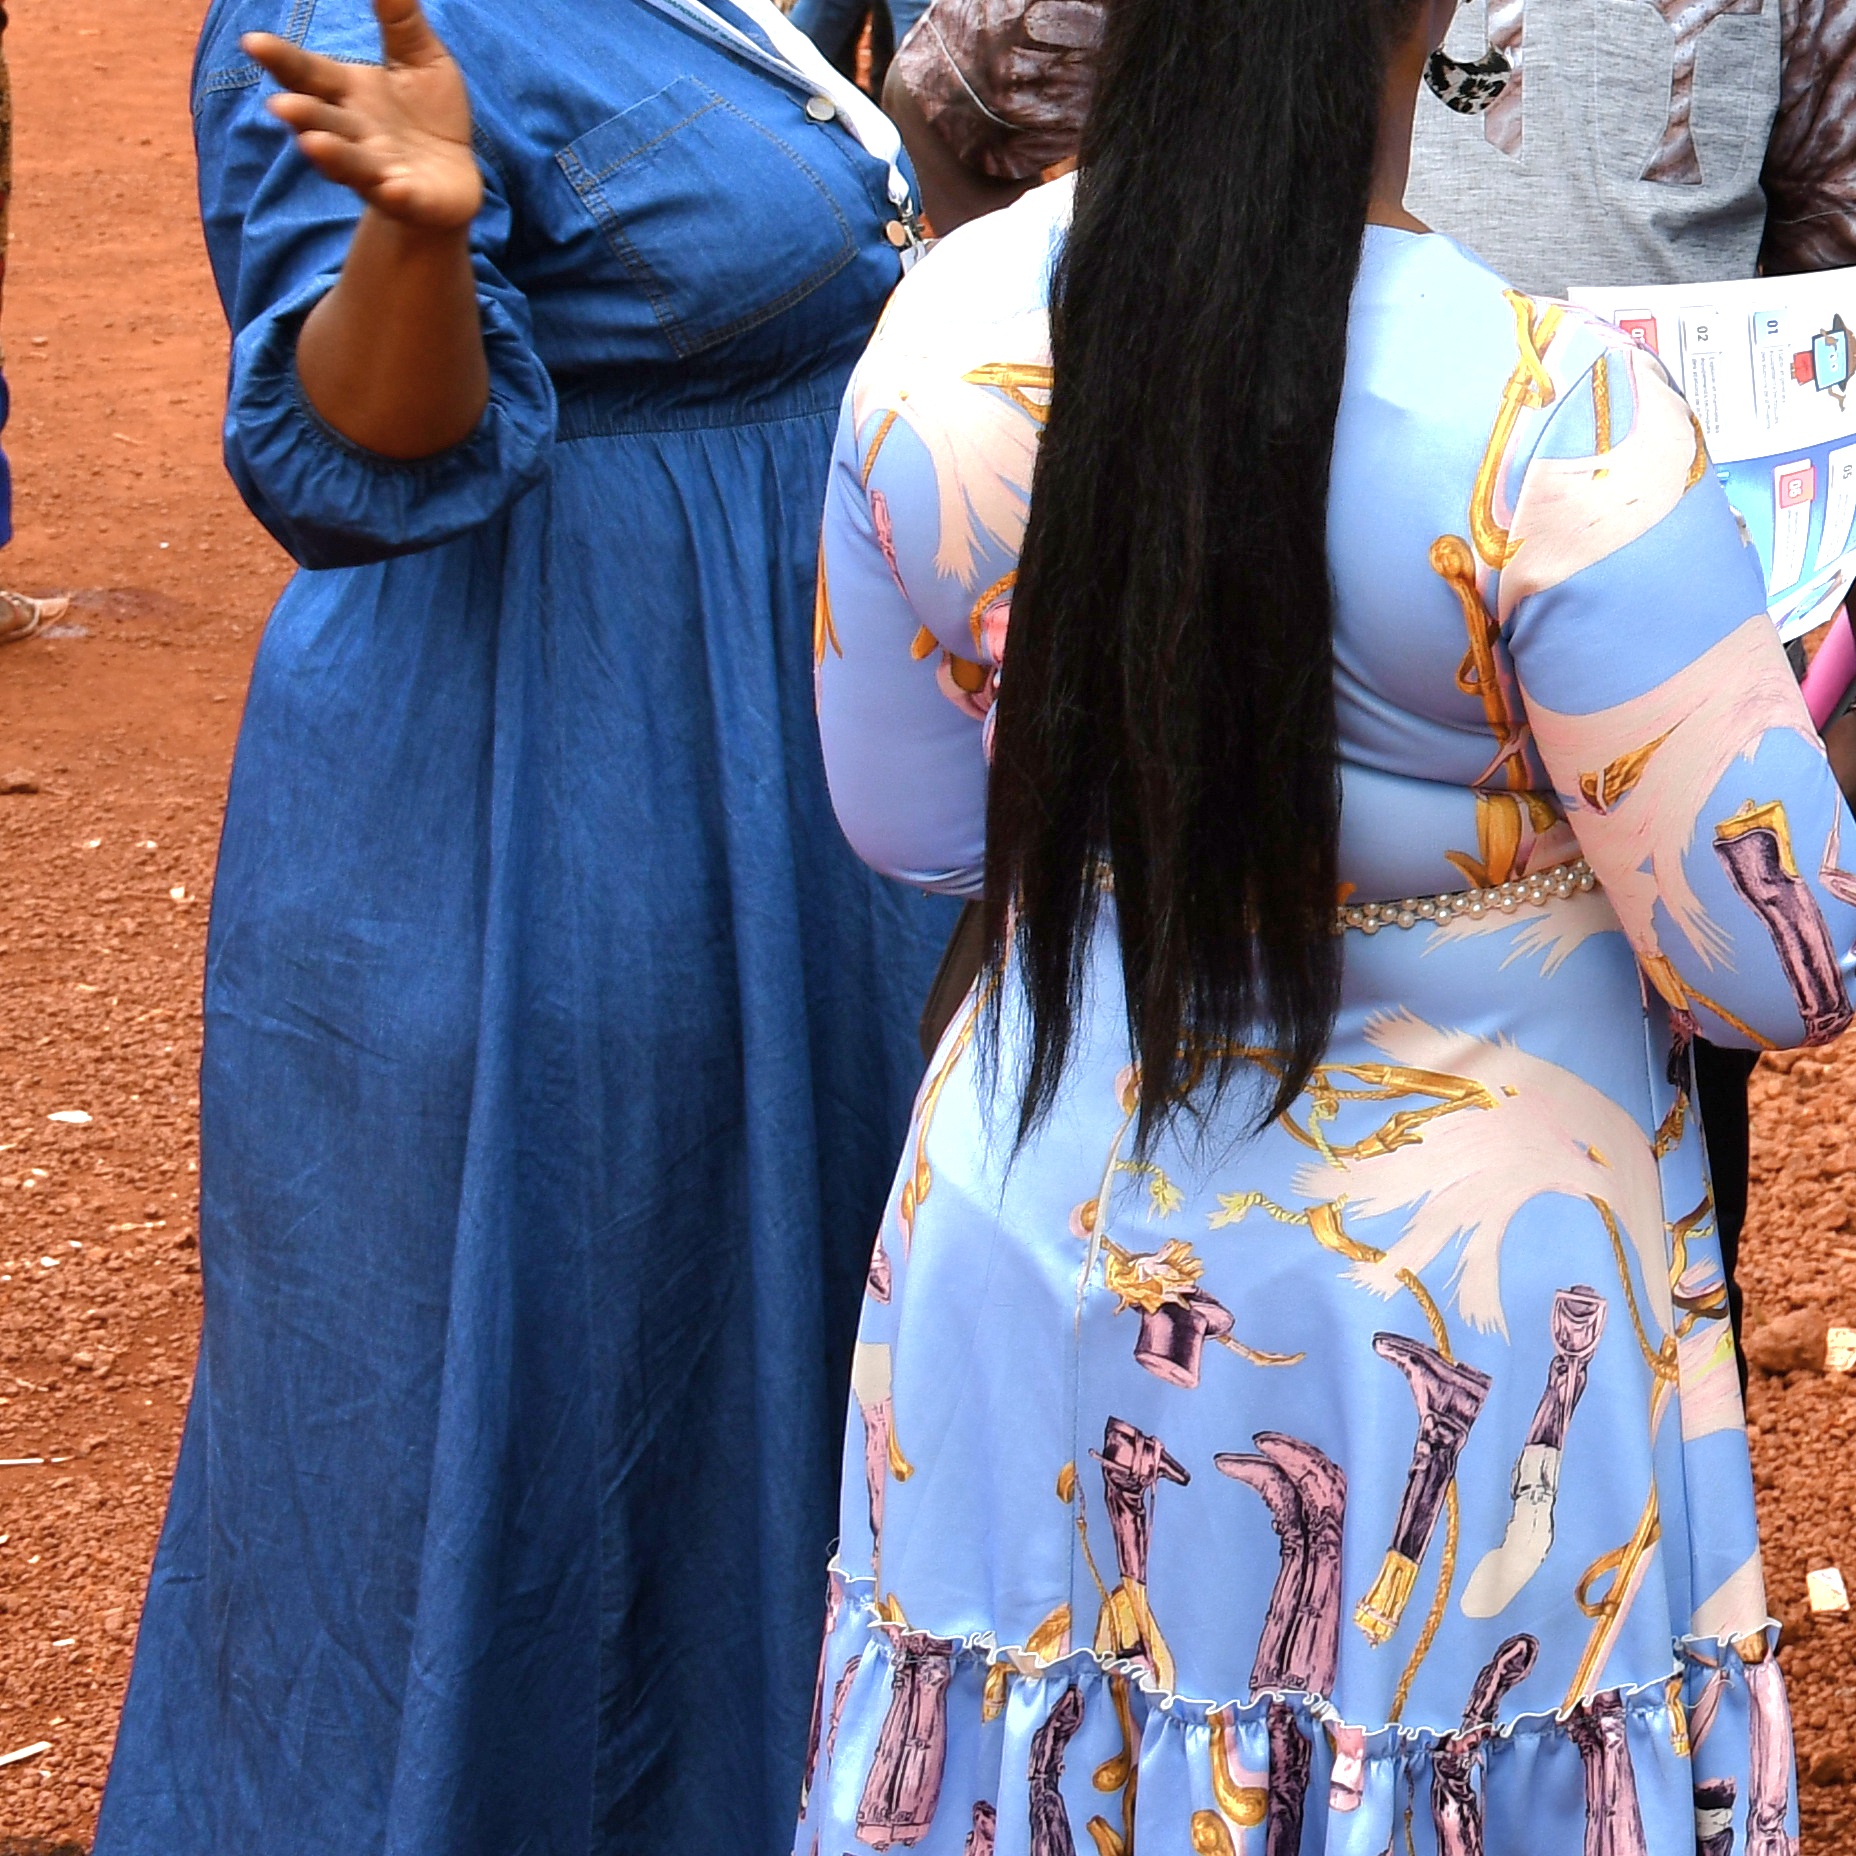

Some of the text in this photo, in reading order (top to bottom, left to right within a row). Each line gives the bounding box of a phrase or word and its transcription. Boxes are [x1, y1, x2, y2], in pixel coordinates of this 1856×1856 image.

[1696, 325, 1708, 342] 02
[1767, 319, 1779, 336] 01
[1842, 464, 1854, 481] 05
